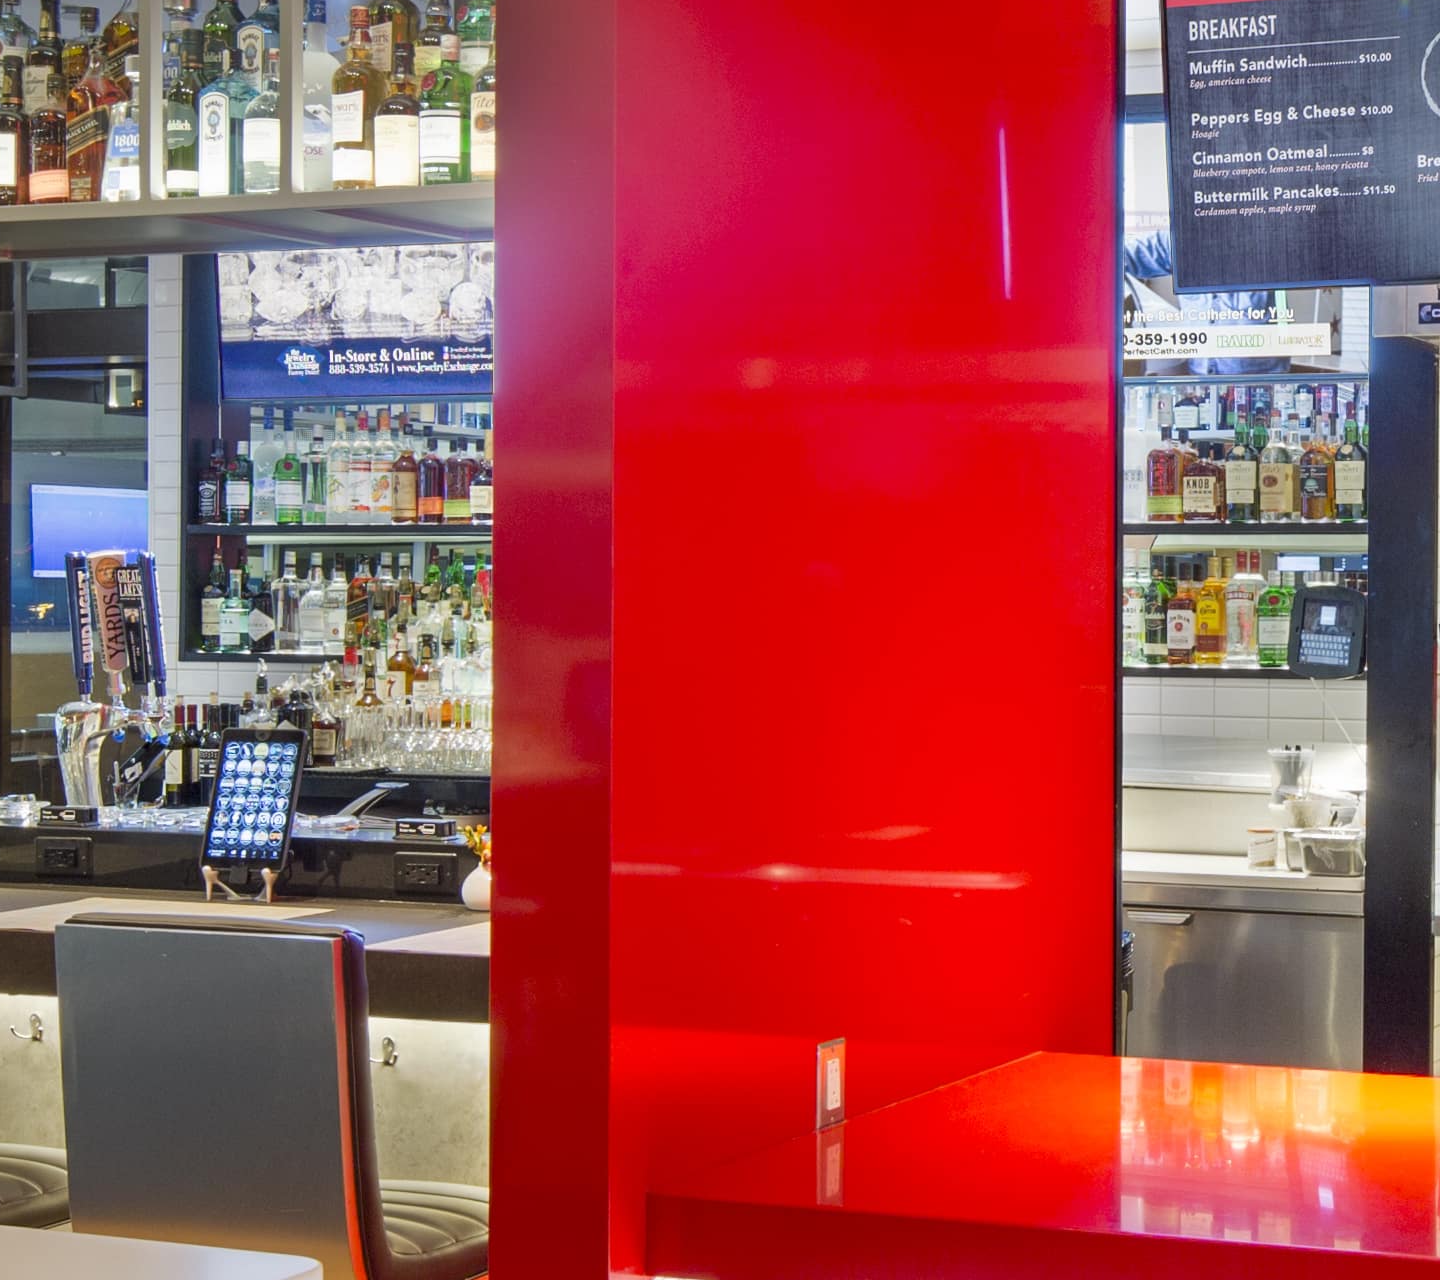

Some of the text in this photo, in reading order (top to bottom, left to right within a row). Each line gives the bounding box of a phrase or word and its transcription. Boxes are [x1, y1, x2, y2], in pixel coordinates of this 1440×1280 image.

[1189, 15, 1277, 41] BREAKFAST
[1190, 61, 1235, 75] Muffin
[1359, 52, 1392, 64] $10.00
[1191, 104, 1393, 129] Peppers Egg & Cheese $10.00
[1191, 129, 1219, 140] Hoagie
[1193, 145, 1374, 165] Cinnamon Oatmeal $8
[1194, 185, 1269, 203] Buttermilk
[1363, 184, 1395, 196] $11.50
[1189, 307, 1294, 320] Catheter for You
[329, 348, 434, 363] In-Store & Online
[1186, 478, 1209, 488] KNOB
[103, 593, 126, 660] YARDS
